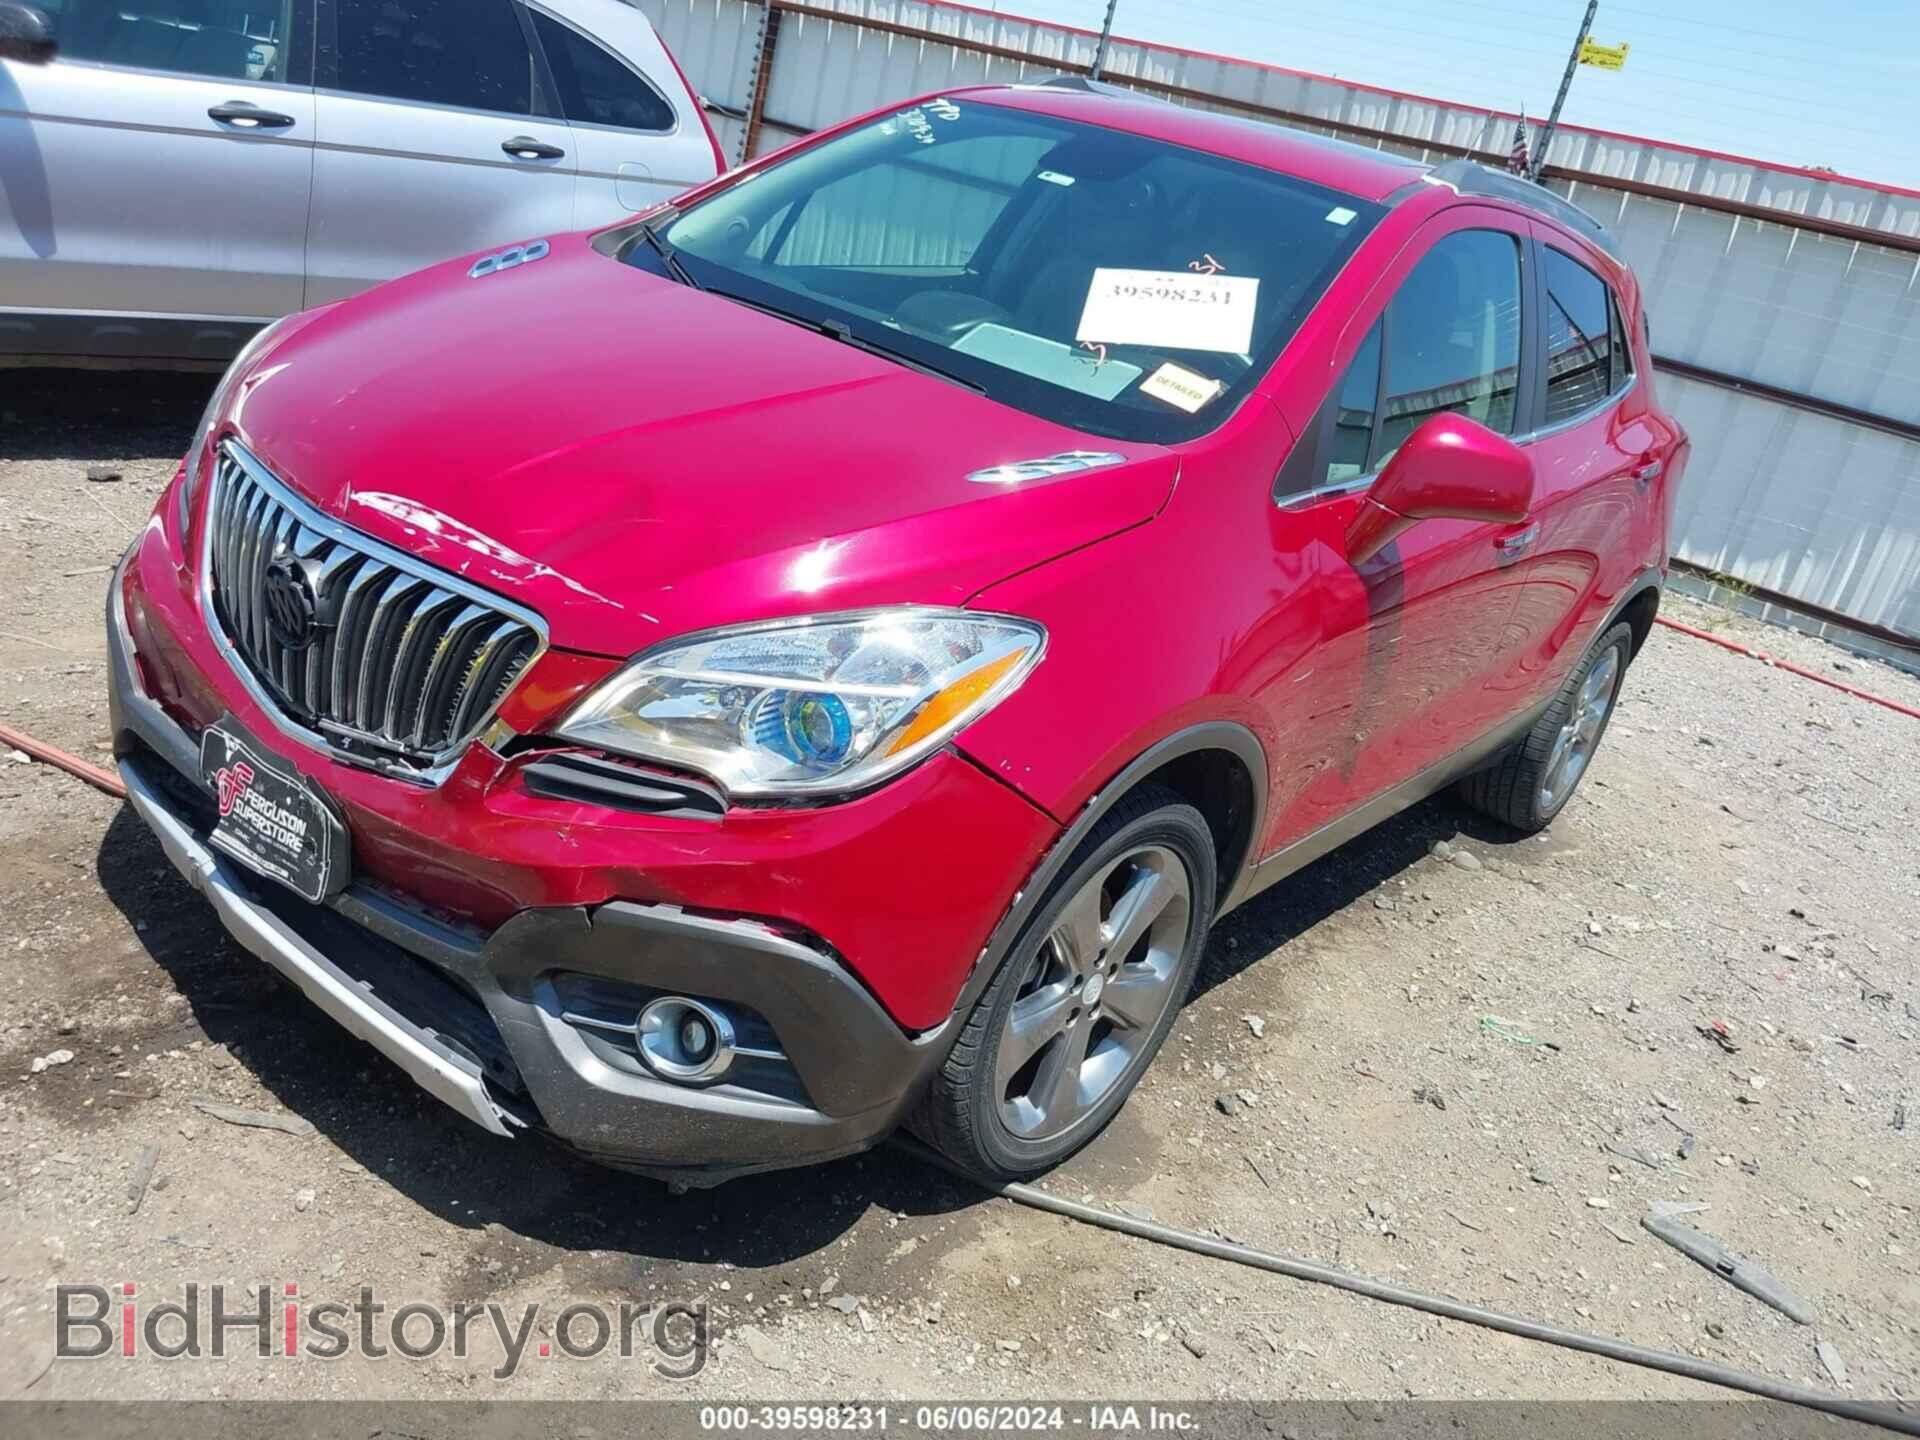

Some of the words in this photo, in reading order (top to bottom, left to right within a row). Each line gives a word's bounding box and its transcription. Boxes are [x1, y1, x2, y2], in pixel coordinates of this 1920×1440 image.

[1155, 376, 1203, 400] DETAILED
[233, 798, 304, 853] SUPERSTORE
[244, 787, 307, 835] FERGUSON
